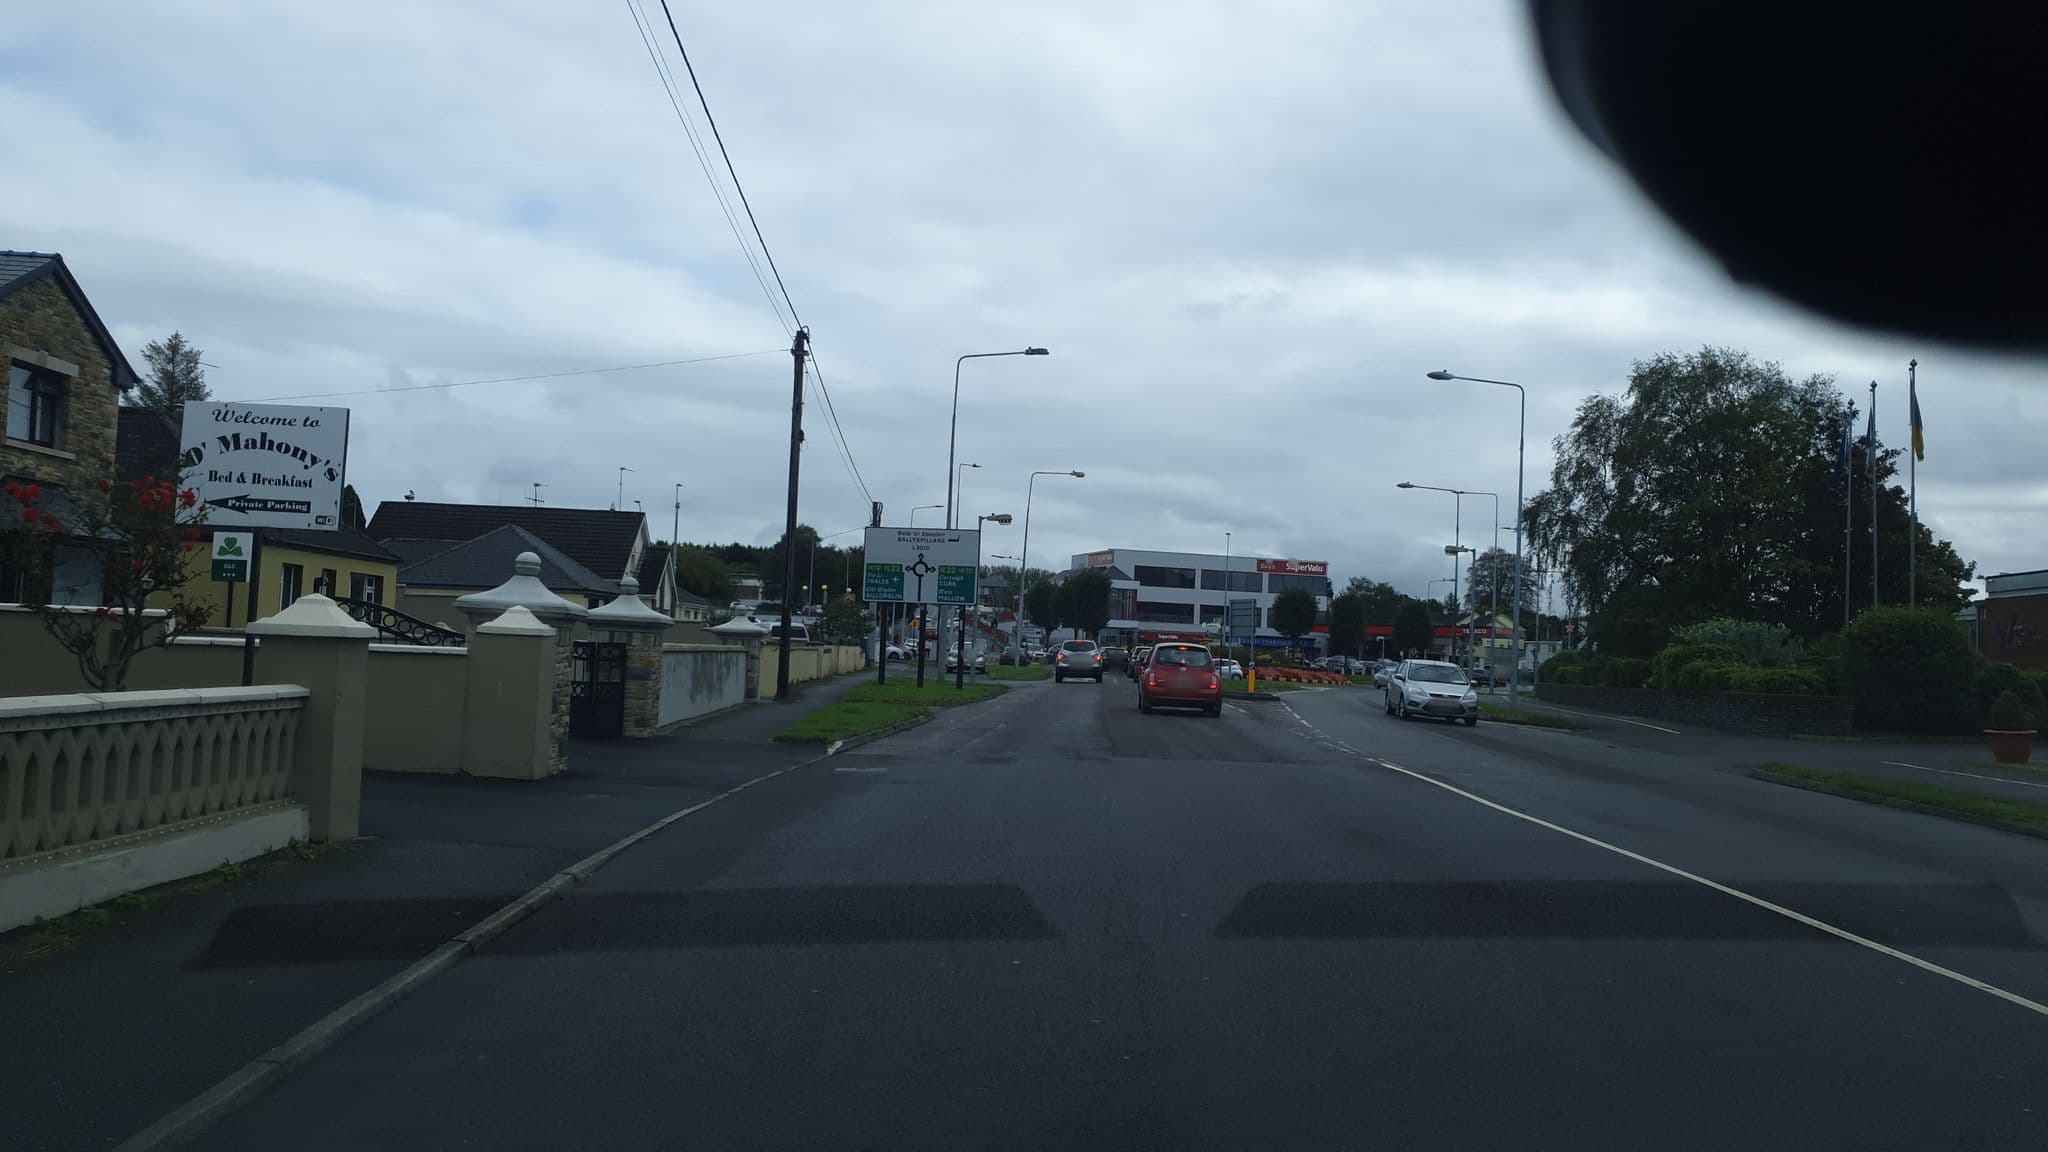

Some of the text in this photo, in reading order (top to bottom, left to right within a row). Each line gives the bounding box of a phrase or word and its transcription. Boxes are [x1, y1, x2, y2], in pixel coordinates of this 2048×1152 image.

[212, 408, 321, 428] Welcome to
[216, 431, 340, 482] Mahony's
[208, 470, 313, 489] Bed & Breakfast
[227, 499, 308, 512] Private Parking
[939, 566, 956, 574] N22
[1286, 562, 1323, 572] SuperValu
